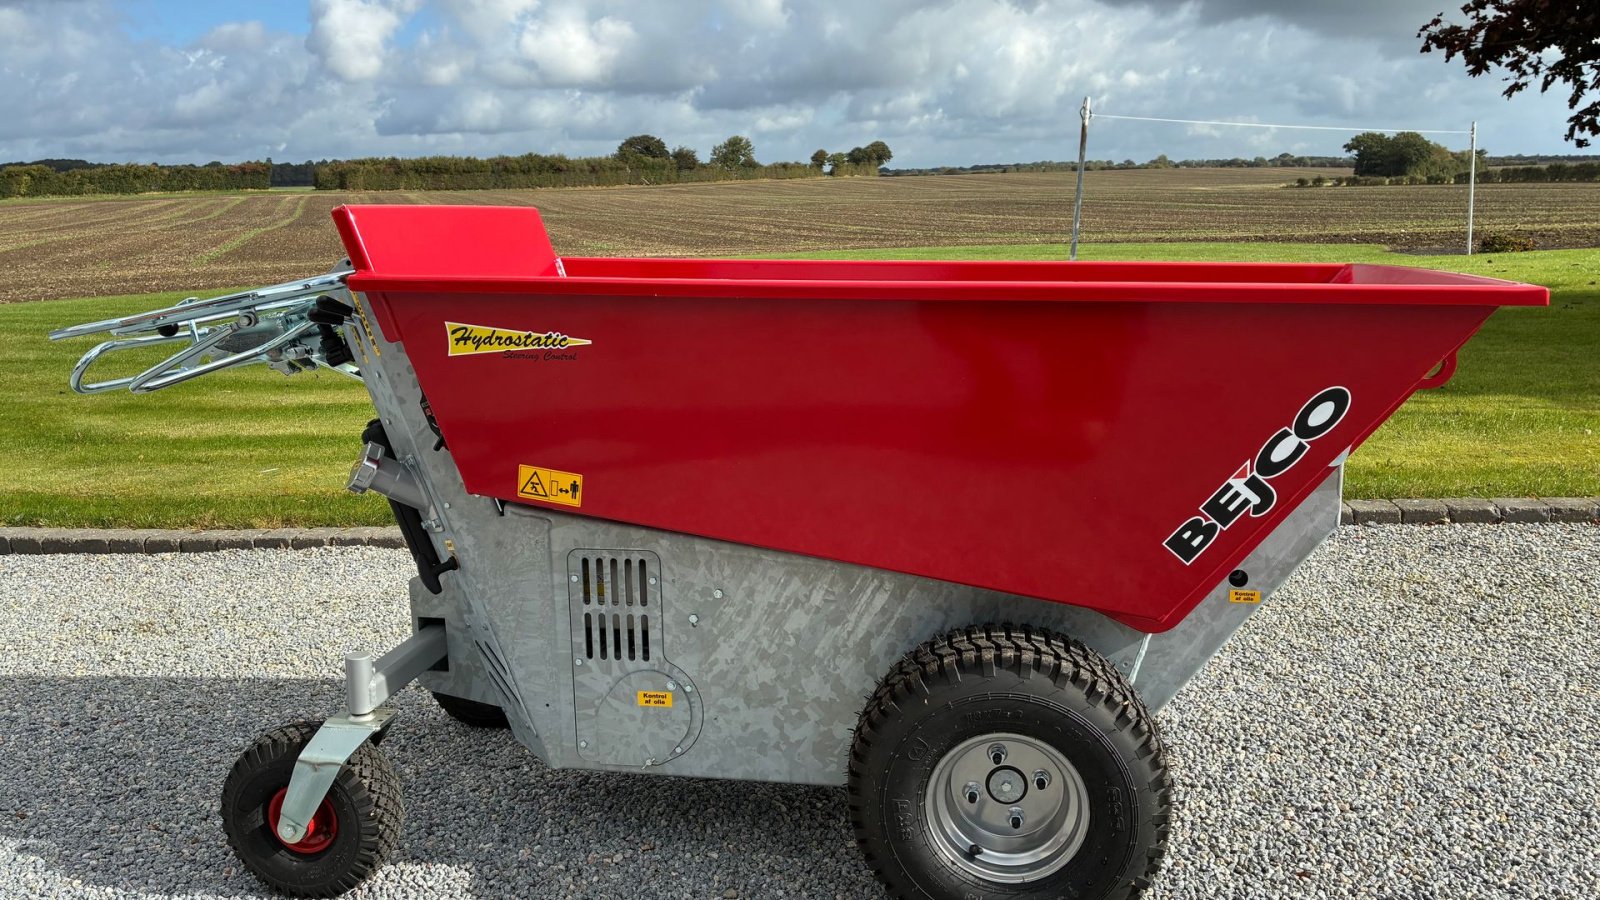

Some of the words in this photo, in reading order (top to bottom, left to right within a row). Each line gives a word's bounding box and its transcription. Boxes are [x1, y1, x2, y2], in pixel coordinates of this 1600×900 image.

[451, 327, 569, 350] Hydrostatic
[503, 350, 538, 362] Steering
[543, 351, 577, 361] Control
